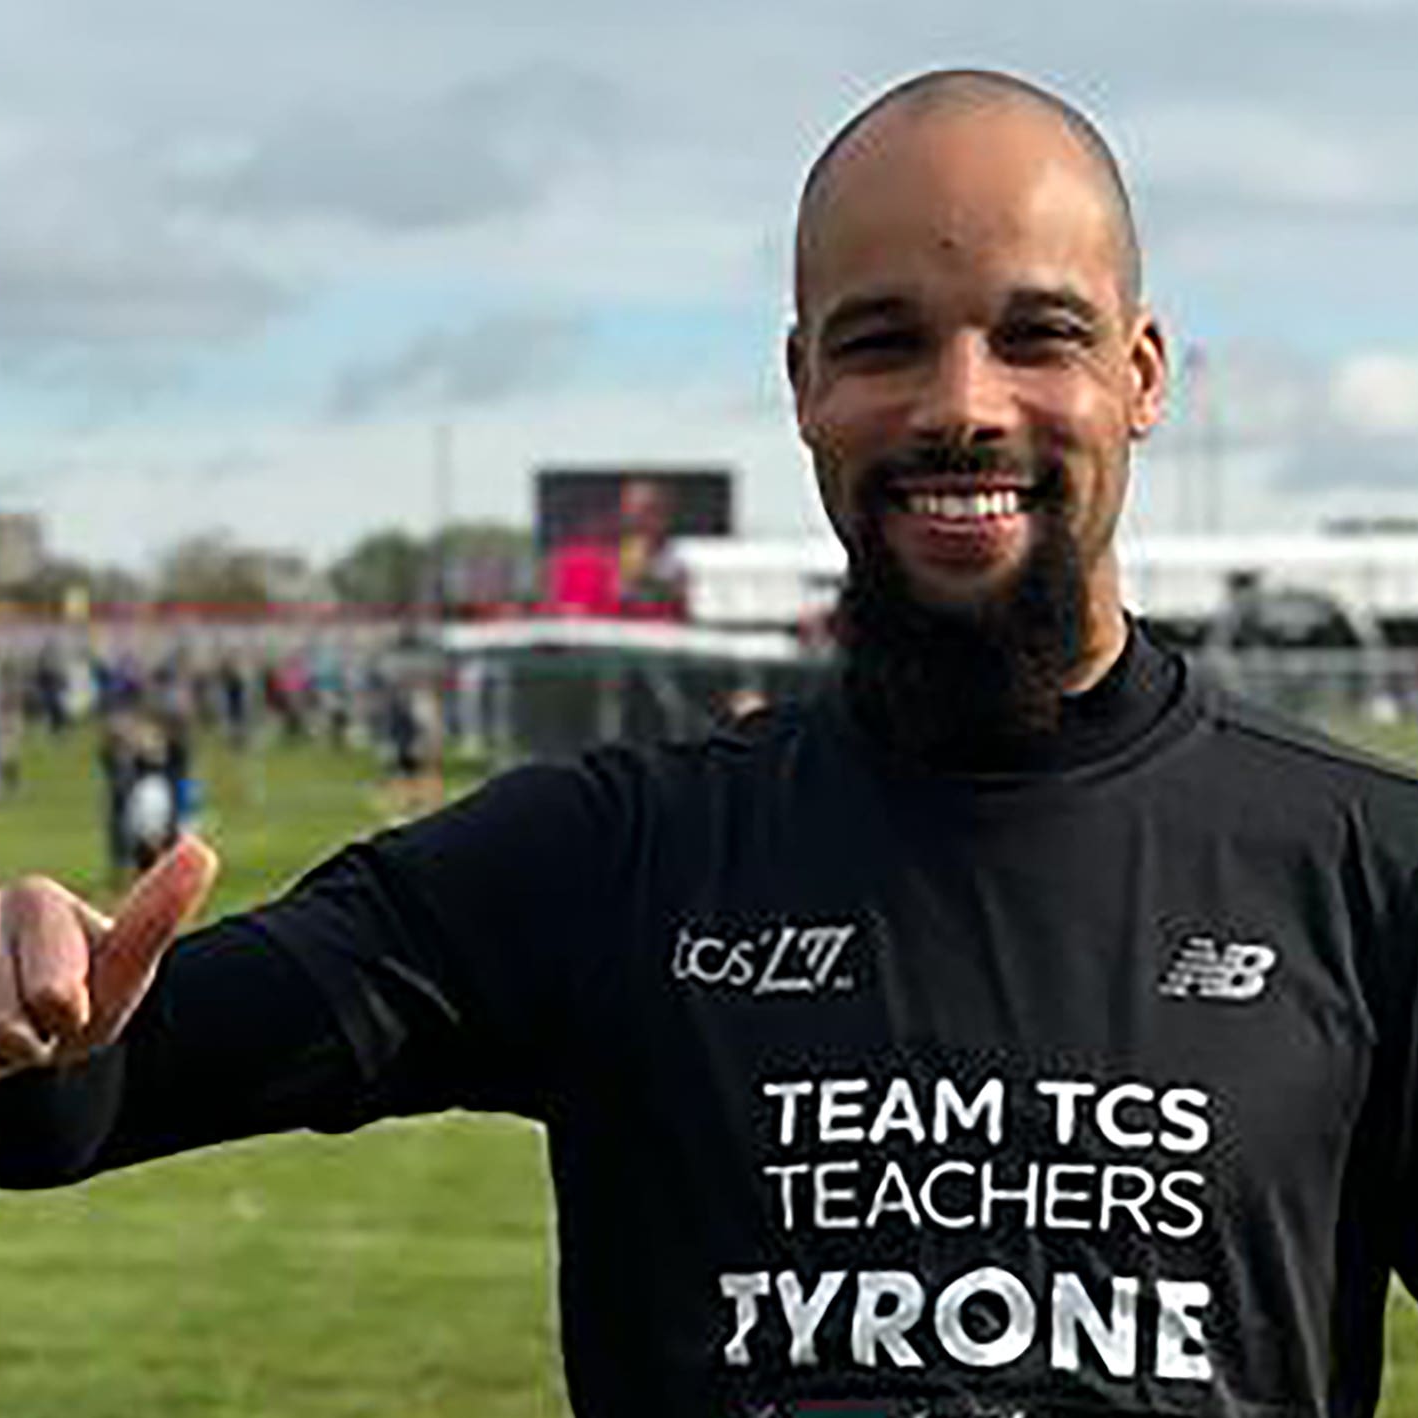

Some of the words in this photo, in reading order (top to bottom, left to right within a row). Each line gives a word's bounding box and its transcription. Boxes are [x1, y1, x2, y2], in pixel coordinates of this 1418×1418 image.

[763, 1078, 1004, 1145] TEAM
[1036, 1080, 1210, 1153] TCS
[763, 1160, 1205, 1239] TEACHERS
[719, 1266, 1213, 1381] TYRONE
